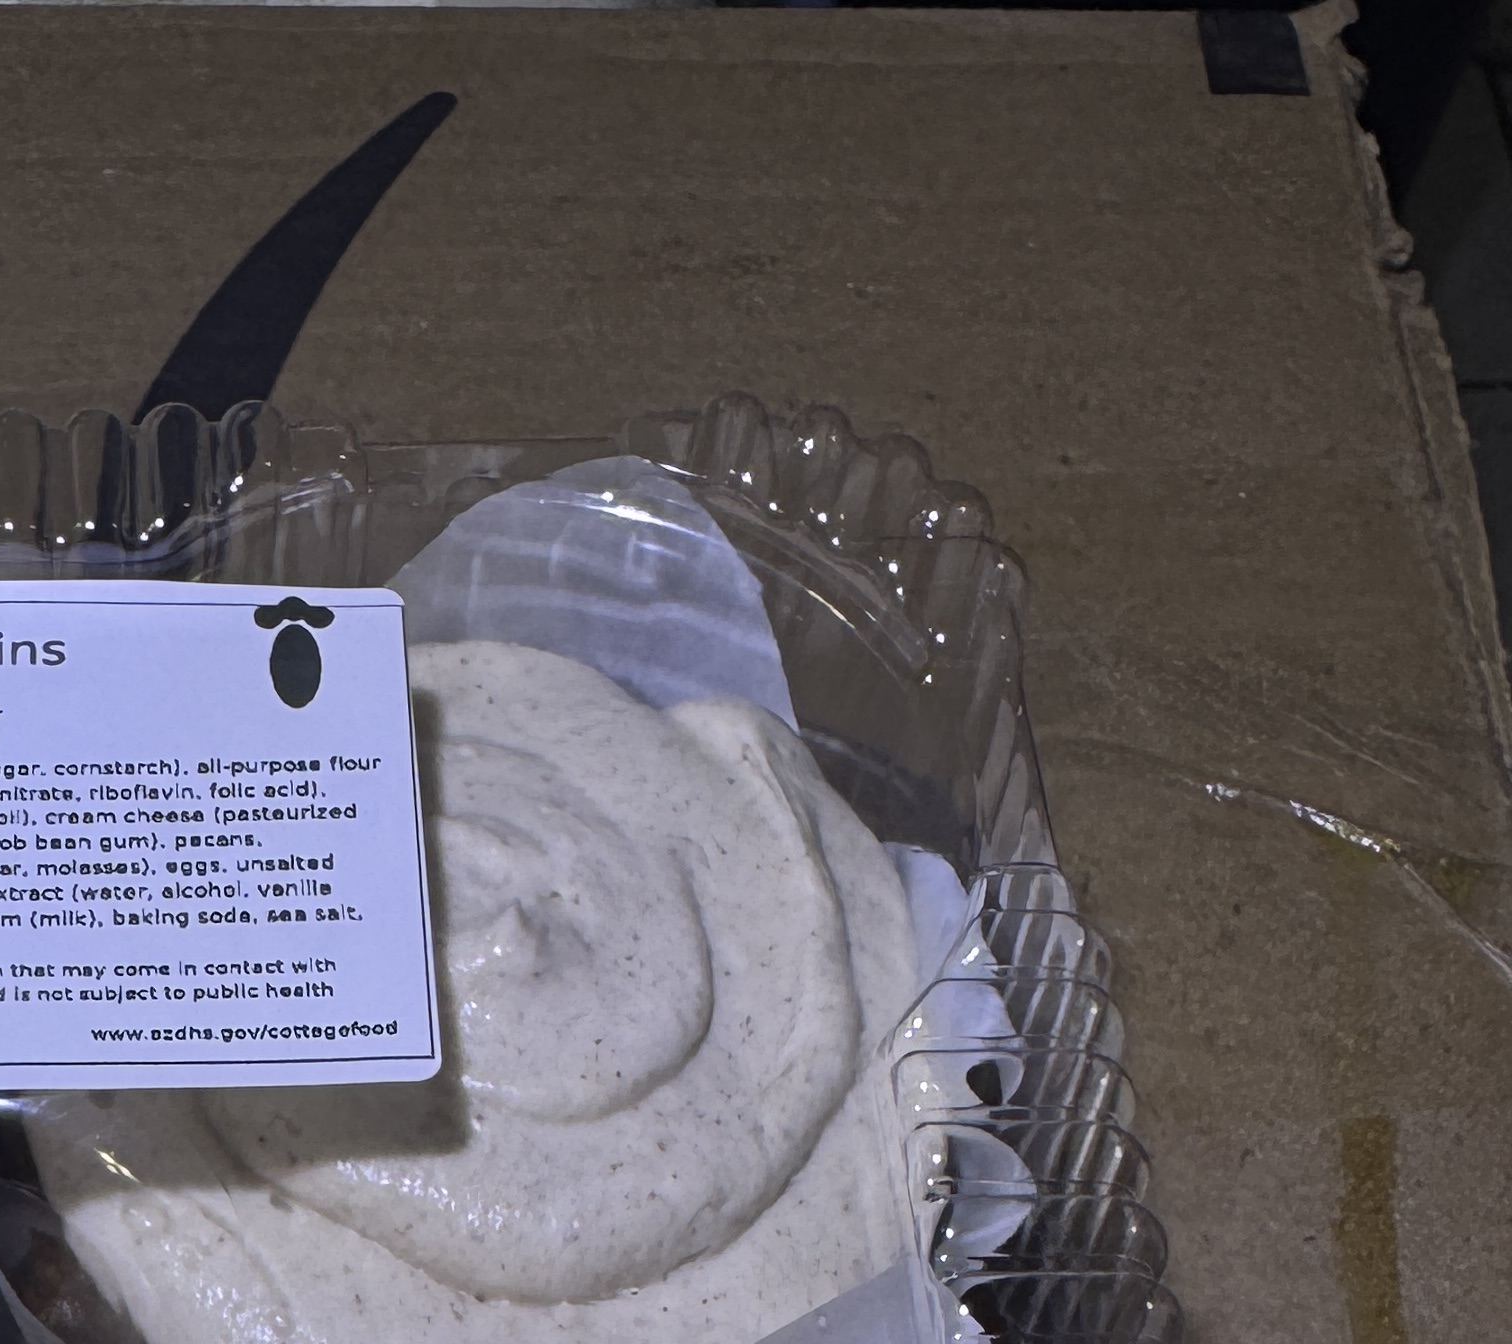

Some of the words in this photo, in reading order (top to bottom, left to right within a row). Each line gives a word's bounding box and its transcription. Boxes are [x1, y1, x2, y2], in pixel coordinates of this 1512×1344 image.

[196, 757, 321, 778] all-purpose
[329, 755, 382, 772] flour
[208, 781, 256, 800] folic
[44, 811, 118, 826] cream
[122, 807, 205, 824] cheese
[35, 833, 92, 851] bean
[236, 852, 335, 873] unsalted
[256, 878, 332, 899] vanilla
[112, 907, 190, 930] baking
[9, 963, 56, 978] that
[61, 965, 107, 981] may
[113, 964, 171, 977] come
[178, 960, 198, 977] in
[203, 959, 286, 976] contact
[291, 956, 337, 975] with
[14, 985, 31, 1002] is
[37, 986, 74, 1002] not
[79, 984, 159, 1005] subject
[163, 985, 187, 1001] to
[192, 982, 259, 1004] public
[265, 980, 334, 999] health
